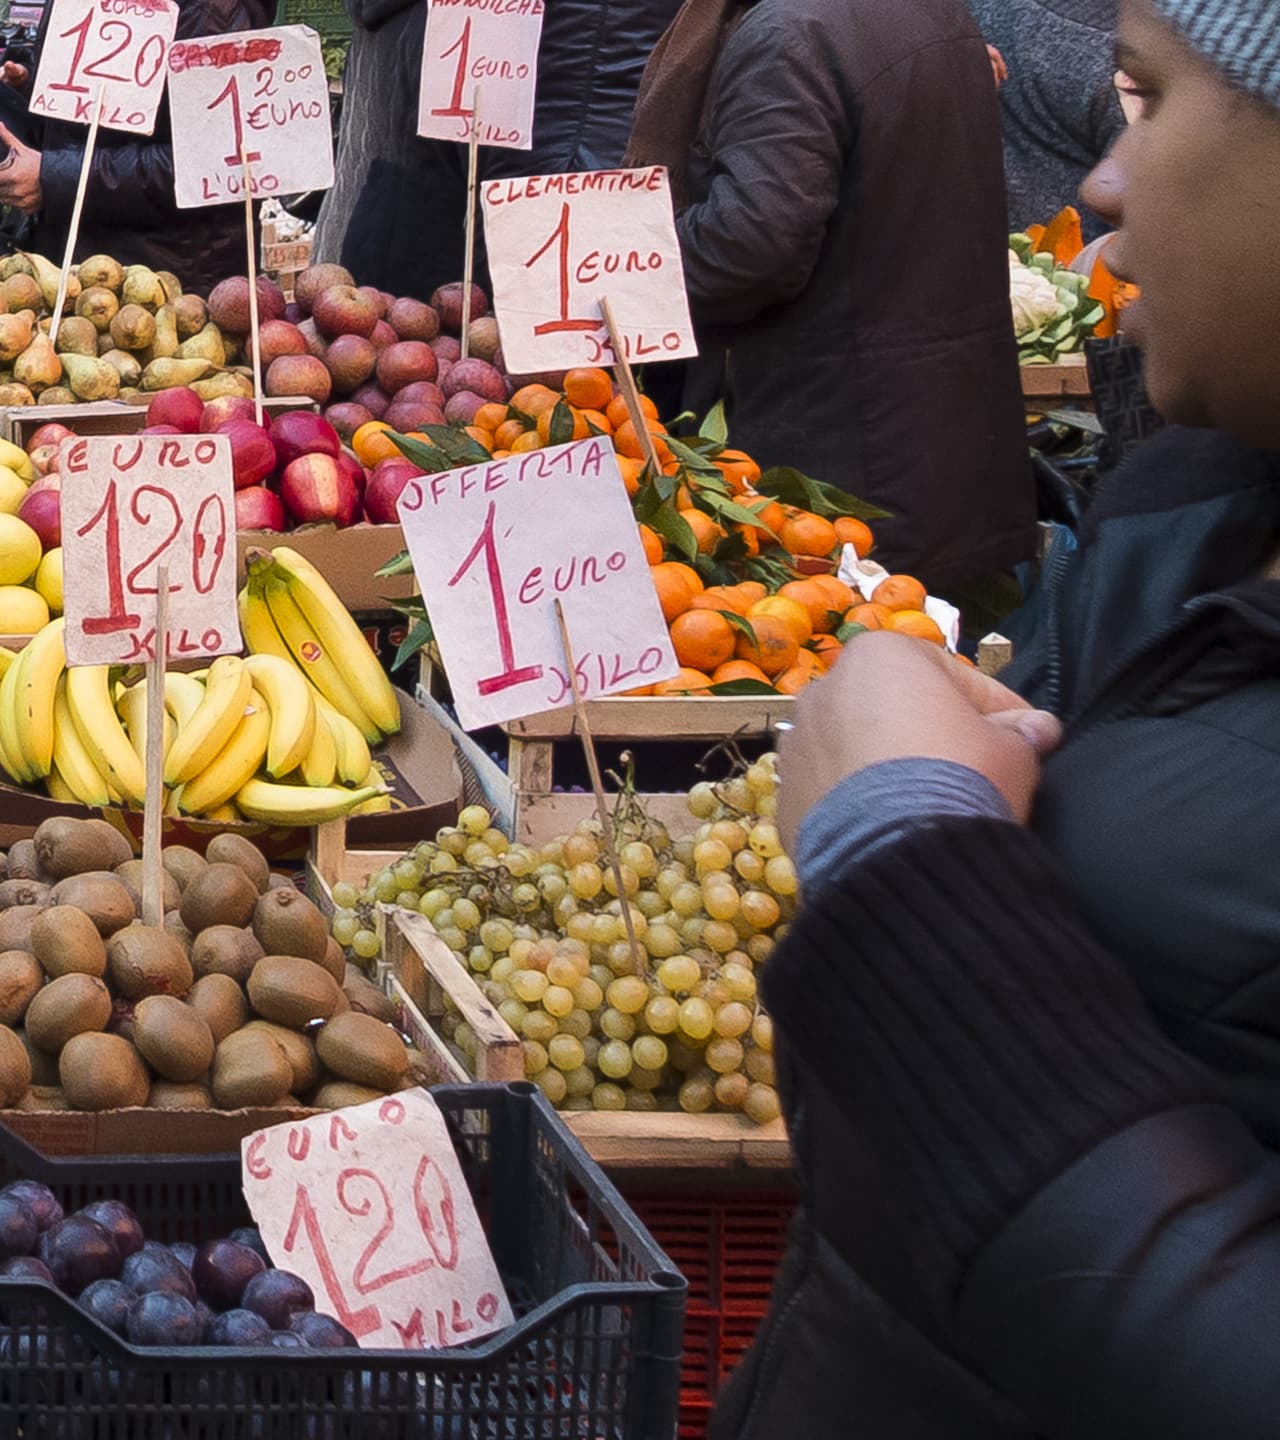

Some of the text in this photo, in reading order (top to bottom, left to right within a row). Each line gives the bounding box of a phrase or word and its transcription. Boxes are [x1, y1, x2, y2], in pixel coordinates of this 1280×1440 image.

[48, 6, 166, 93] 120
[471, 55, 530, 80] EURO
[32, 93, 147, 127] AL KILO
[485, 165, 666, 207] CLEMENTINE
[524, 201, 663, 336] 1 EURO
[67, 438, 217, 474] EURO
[77, 478, 226, 635] 120
[448, 499, 544, 697] 1
[119, 627, 223, 660] KILO
[245, 1098, 407, 1181] EURO
[282, 1154, 460, 1339] 120
